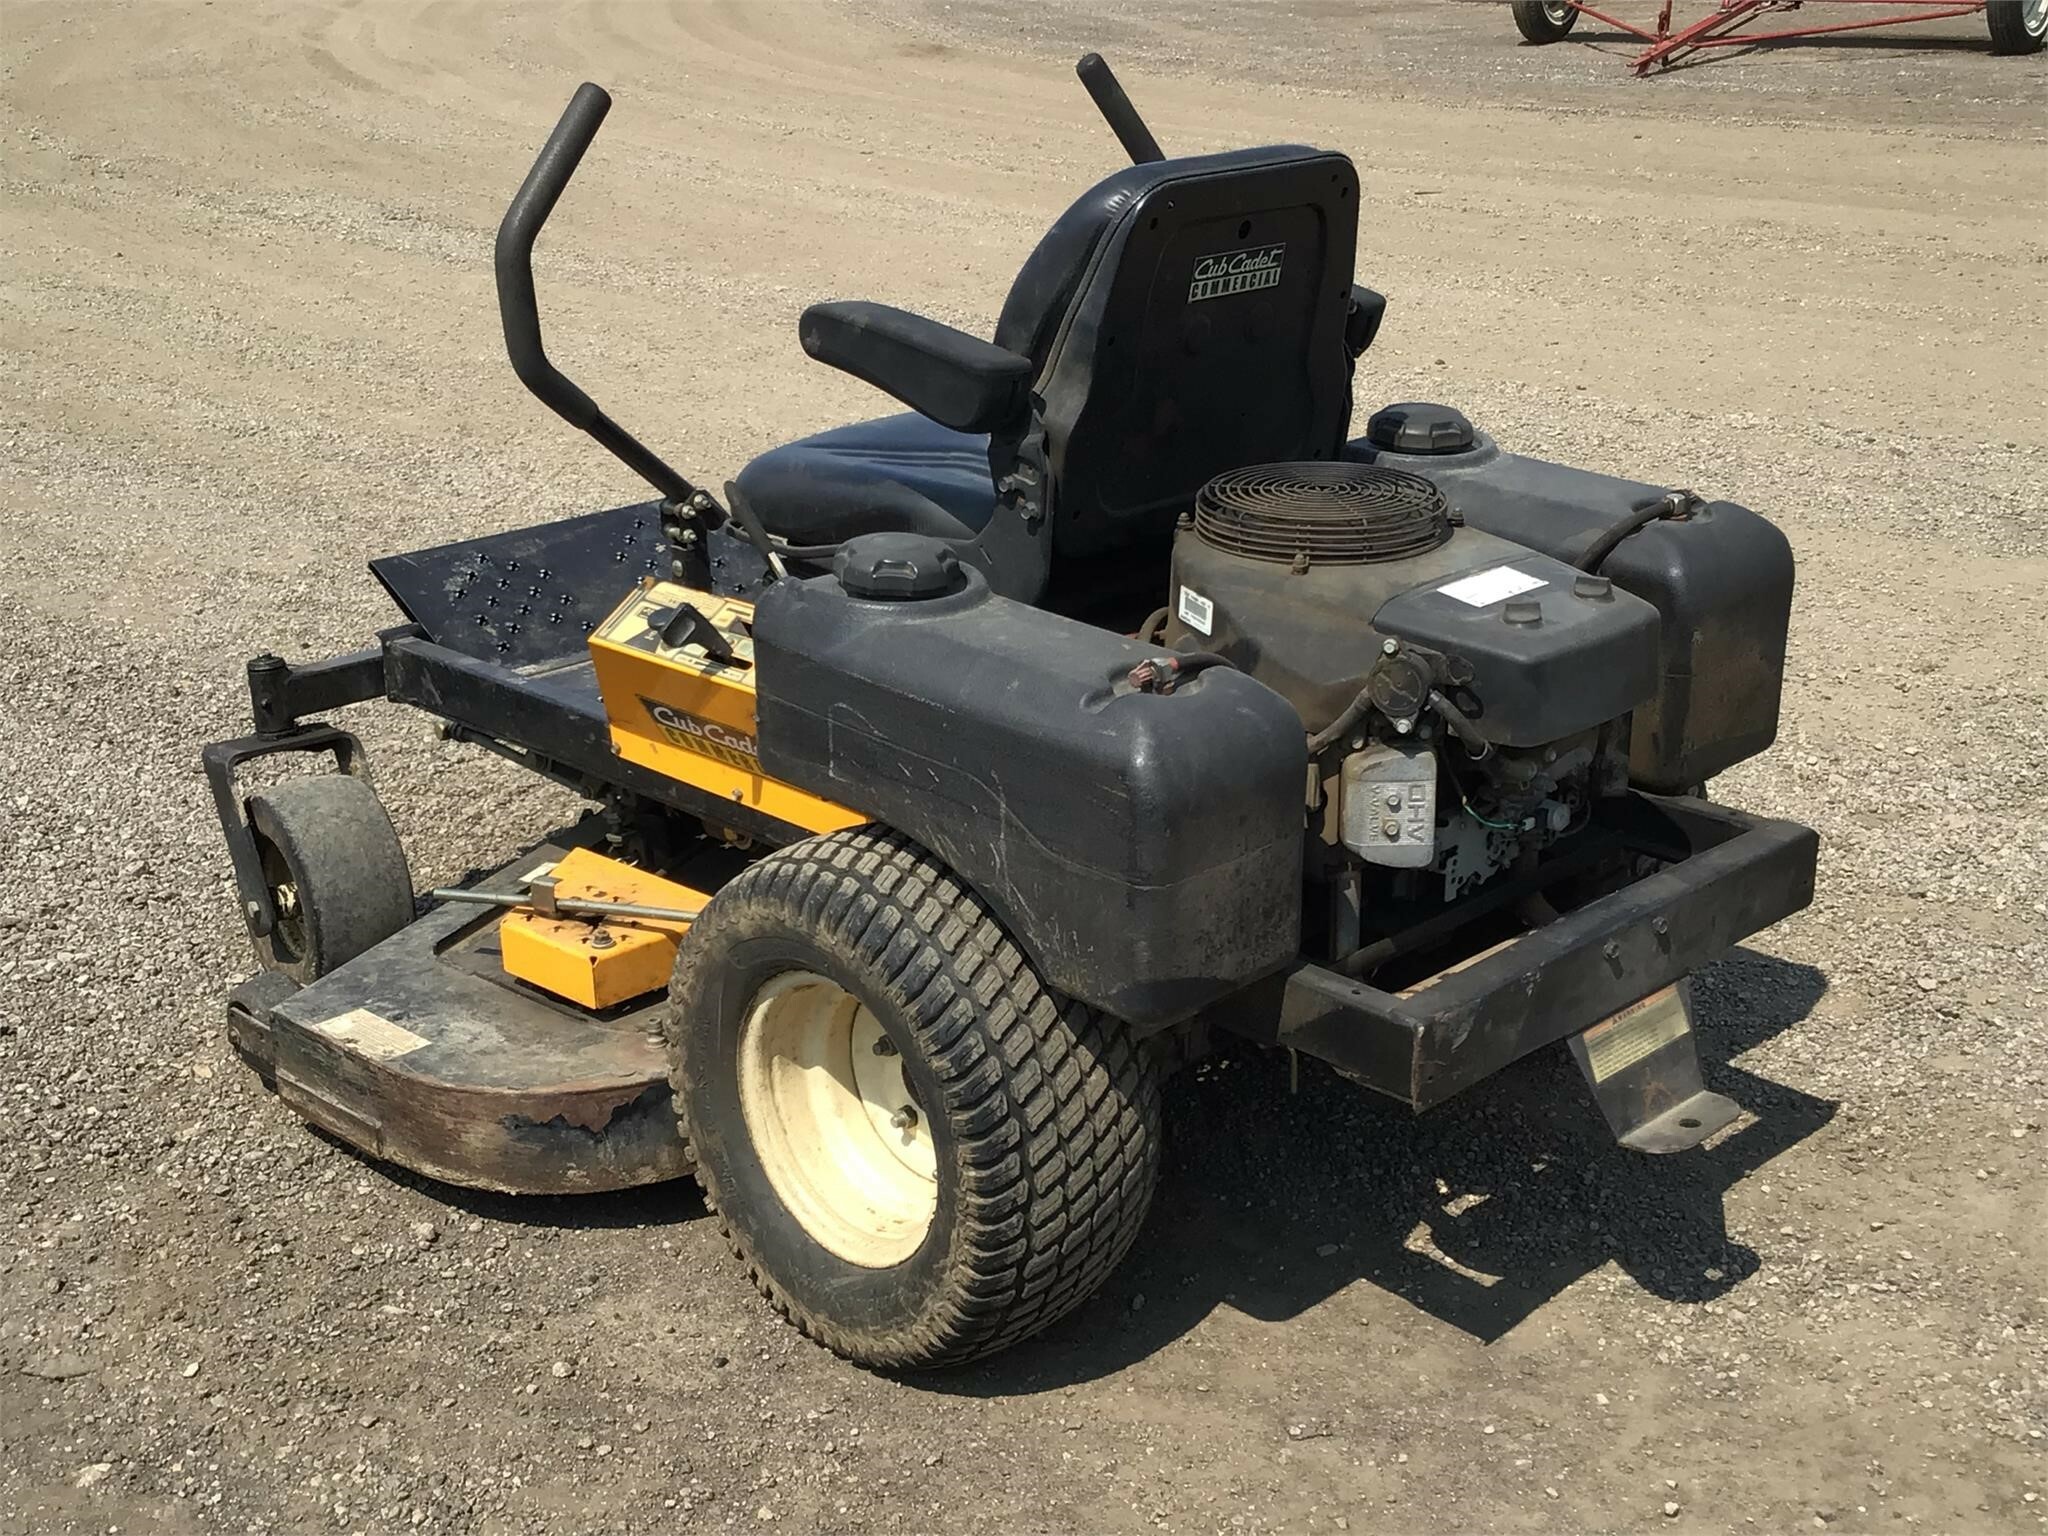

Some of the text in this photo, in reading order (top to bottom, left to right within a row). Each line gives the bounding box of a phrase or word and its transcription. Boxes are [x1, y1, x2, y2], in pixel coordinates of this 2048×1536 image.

[1190, 267, 1280, 299] COMMERCIAL
[1194, 248, 1283, 280] Cub Cadet
[653, 706, 758, 757] Cub Cad
[1406, 784, 1425, 843] OHV
